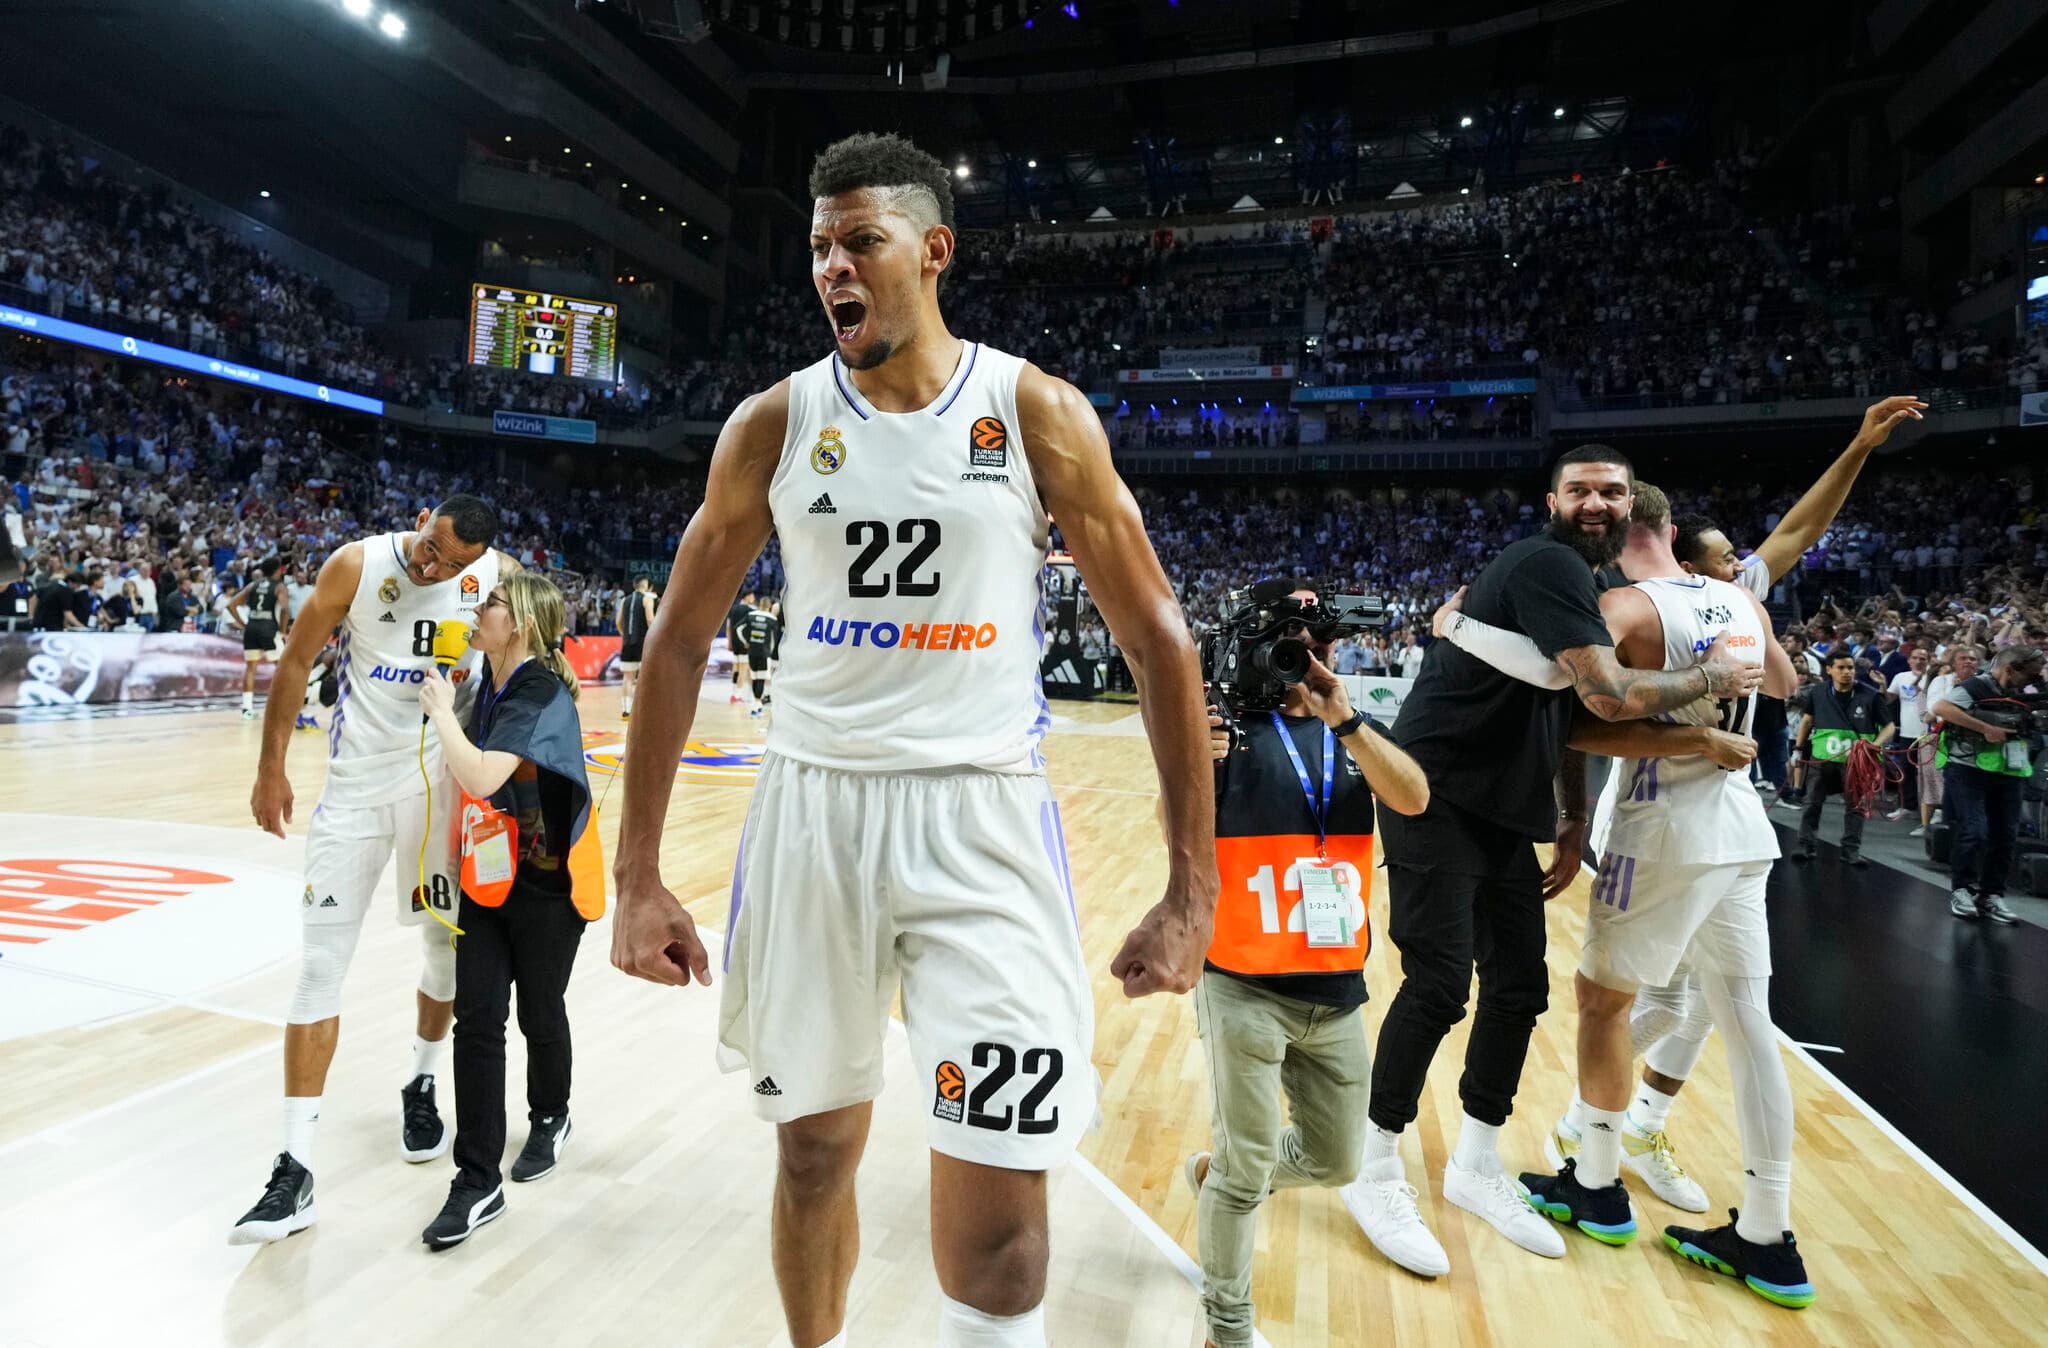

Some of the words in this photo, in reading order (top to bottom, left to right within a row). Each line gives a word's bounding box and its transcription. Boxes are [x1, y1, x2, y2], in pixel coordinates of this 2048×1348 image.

[535, 328, 554, 340] 0.0
[1152, 368, 1205, 378] Comunid
[1208, 369, 1220, 377] de
[1223, 368, 1257, 377] Madrid
[961, 472, 1009, 483] oneteam
[808, 505, 837, 514] adidas
[845, 519, 941, 598] 22
[412, 620, 437, 656] 8
[807, 616, 997, 650] AUTOHERO
[432, 874, 452, 911] 8
[754, 1086, 783, 1096] adidas
[967, 1041, 1063, 1134] 22
